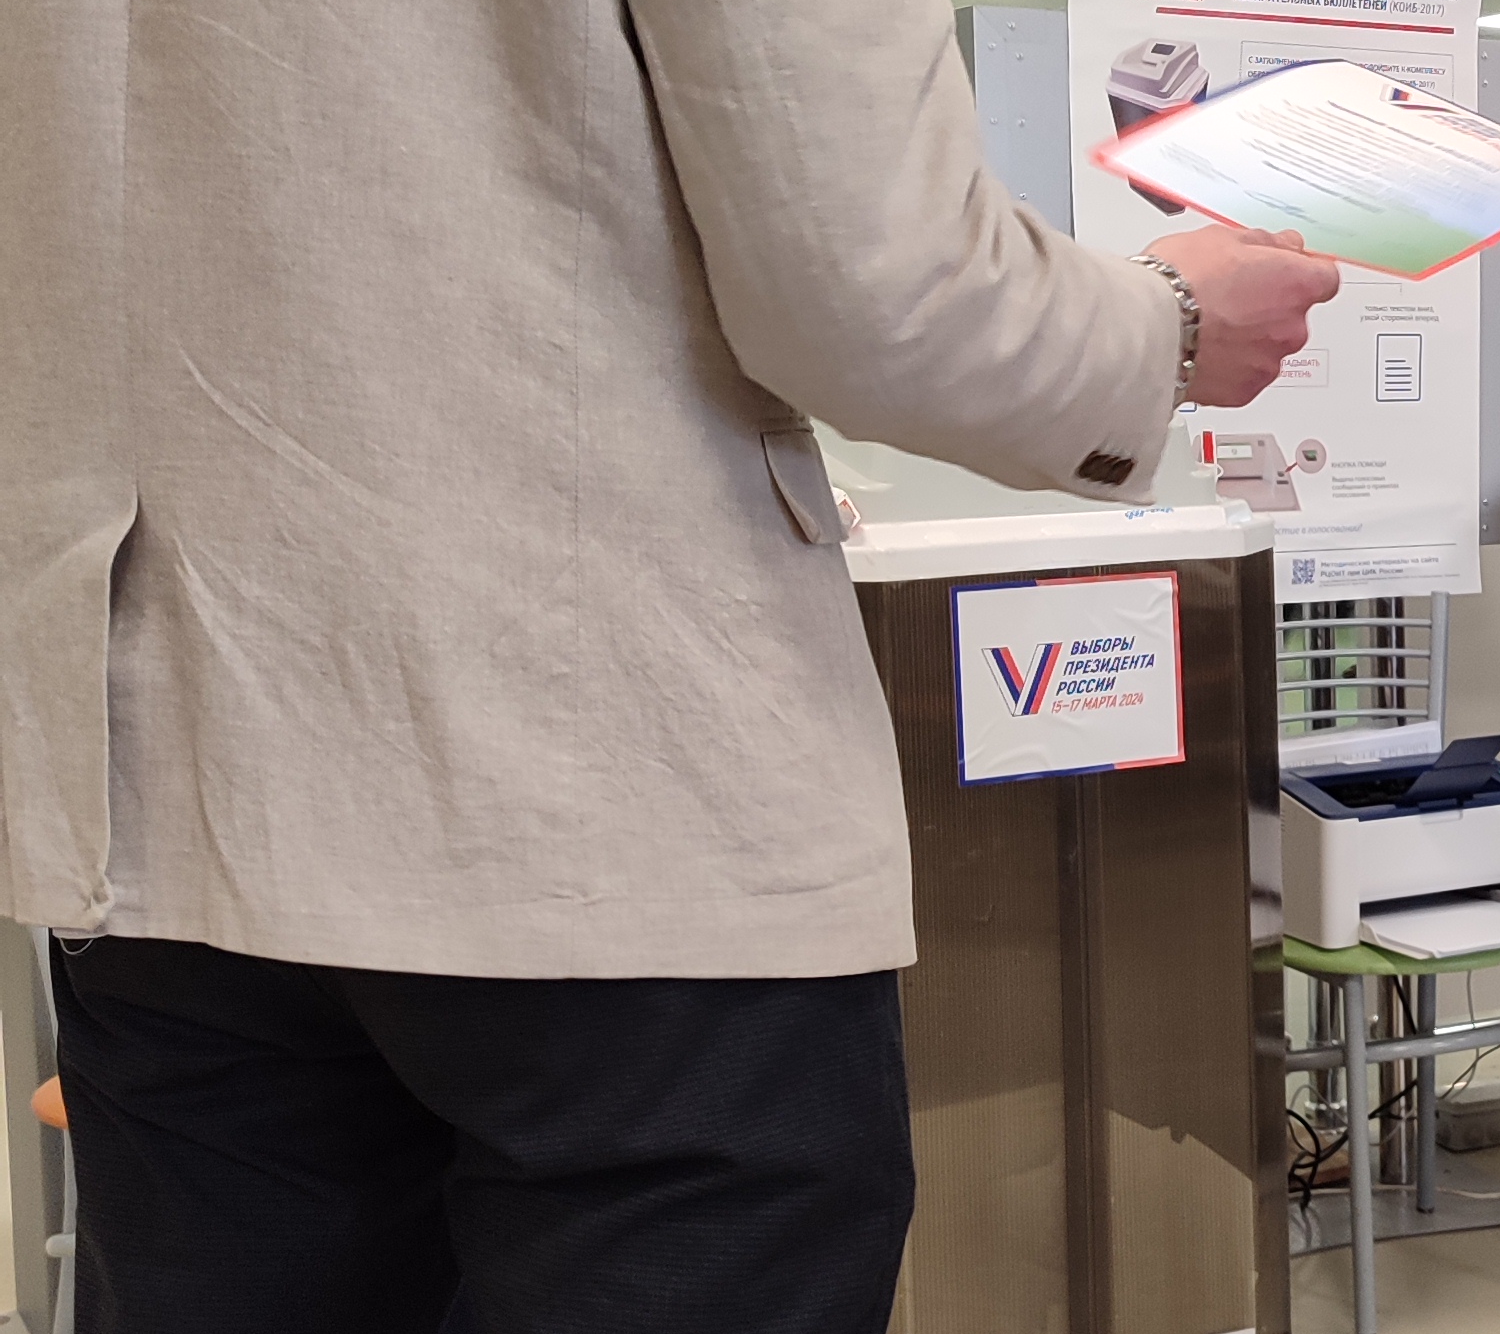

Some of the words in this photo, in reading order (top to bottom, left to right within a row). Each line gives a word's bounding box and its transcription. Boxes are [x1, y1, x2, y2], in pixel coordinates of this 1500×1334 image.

[1389, 0, 1445, 17] (КОИБ-2017)
[1070, 635, 1136, 656] ВЫБОРЫ
[1063, 653, 1155, 676] ПРЕЗИДЕНТА
[1056, 676, 1116, 696] РОССИИ
[1082, 695, 1117, 711] МАРТА
[1119, 692, 1144, 705] 2024
